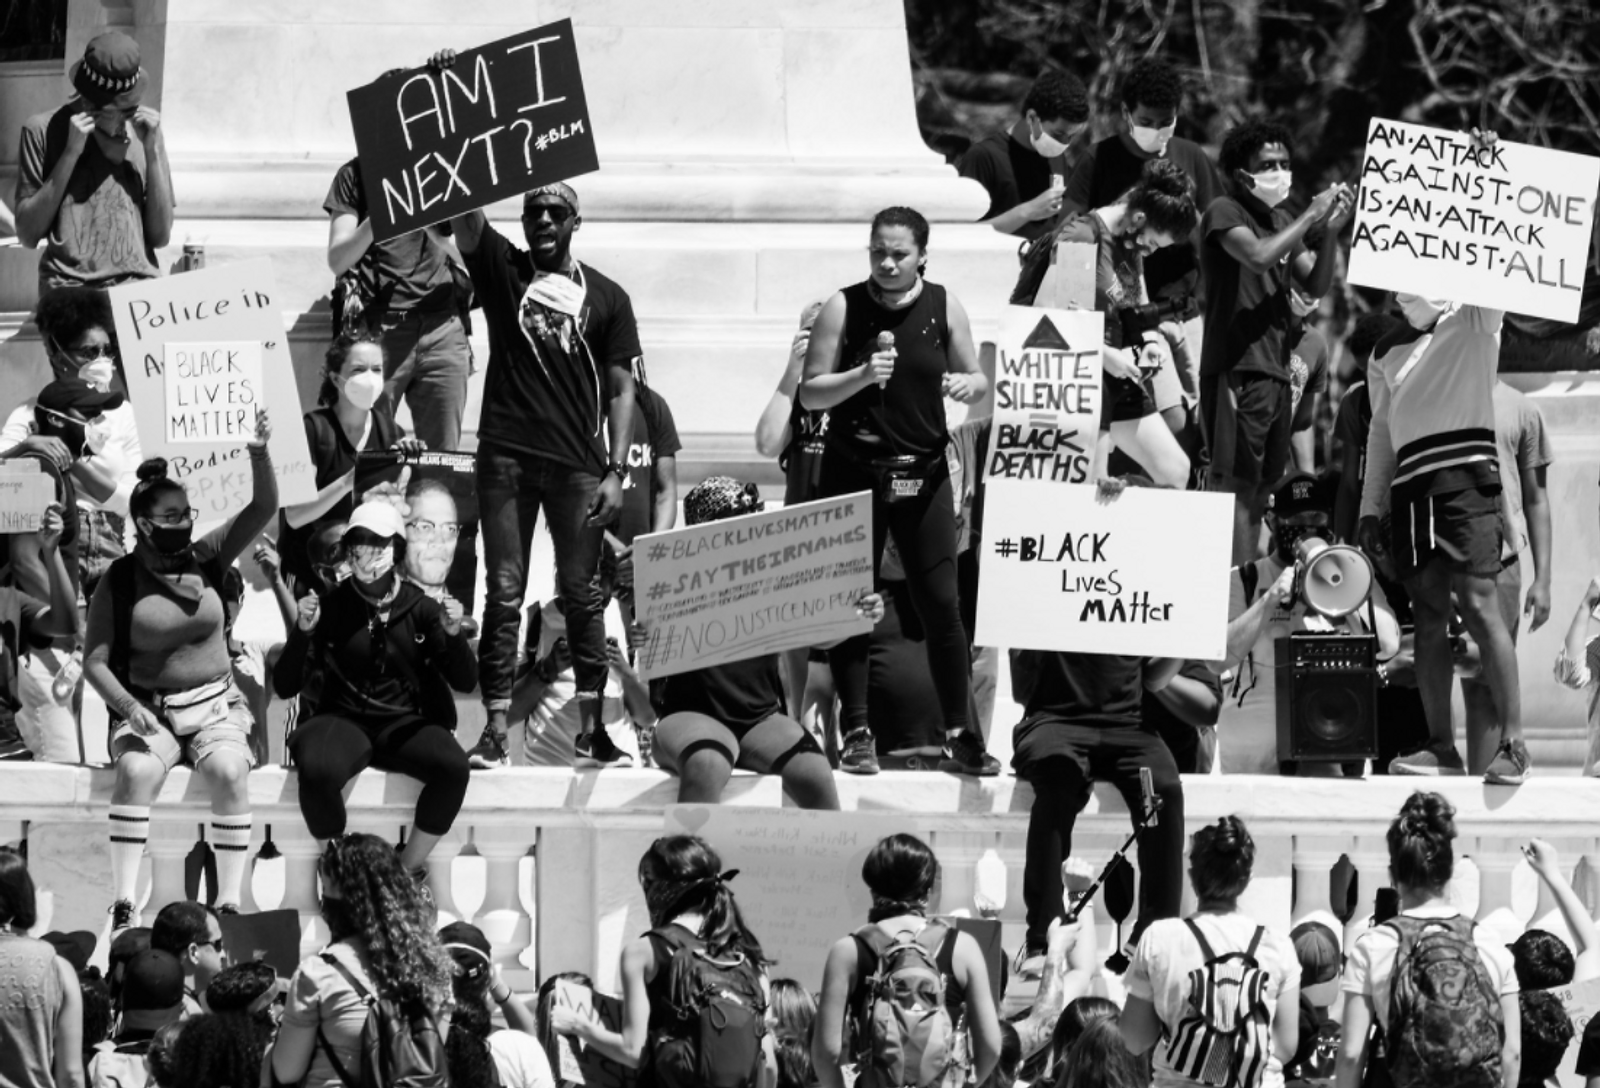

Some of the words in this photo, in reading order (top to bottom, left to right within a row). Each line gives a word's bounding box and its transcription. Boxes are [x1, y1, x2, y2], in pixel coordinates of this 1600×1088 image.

[397, 54, 496, 151] AM
[507, 35, 566, 113] I
[535, 119, 585, 151] #BLM
[382, 118, 533, 224] NEXT?
[129, 299, 229, 341] Police
[241, 288, 270, 308] in
[175, 349, 242, 379] BLACK
[1001, 350, 1099, 380] WHITE
[177, 379, 254, 406] LIVES
[996, 380, 1099, 414] SILENCE
[996, 424, 1085, 454] BLACK
[989, 451, 1090, 484] DEATHS
[647, 503, 854, 562] #BLACKLIVESMATTER
[995, 532, 1111, 562] #BLACK
[646, 524, 867, 600] #SAYTHEIRNAMES
